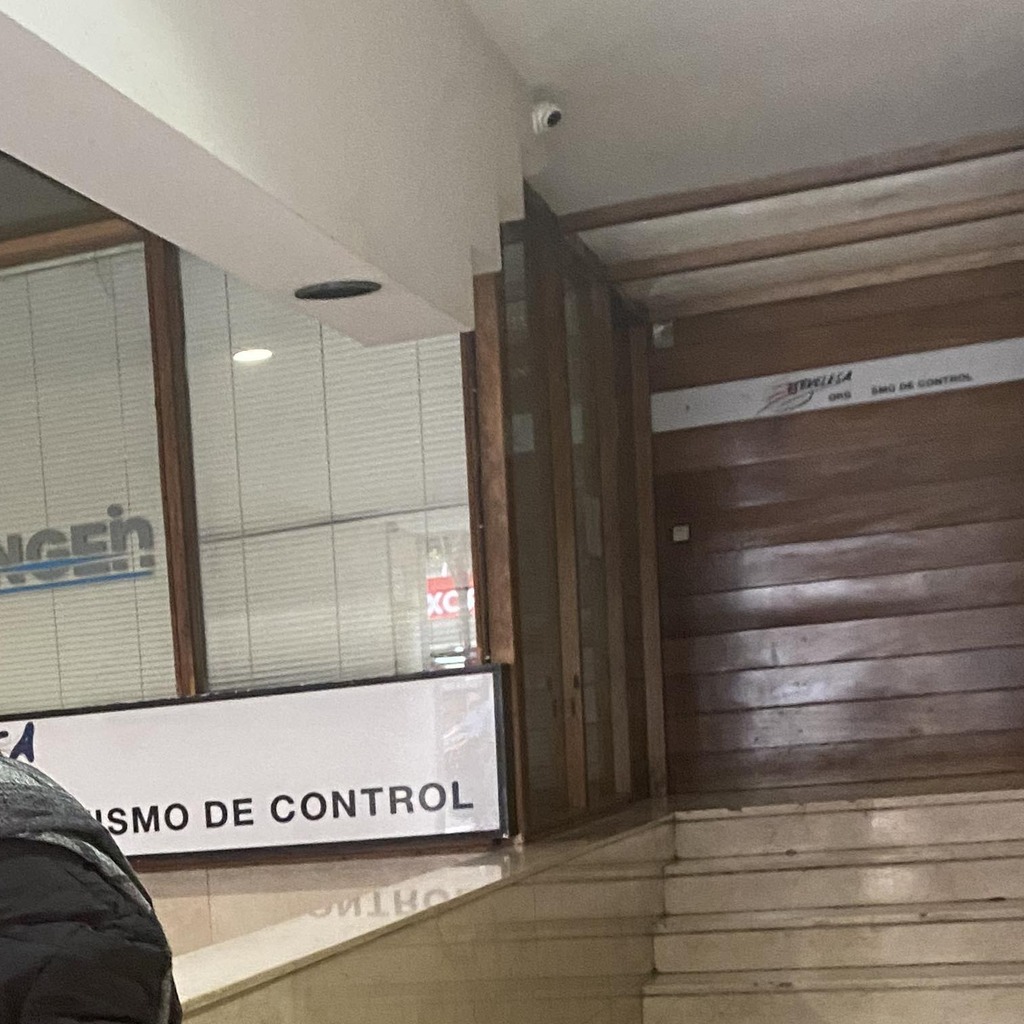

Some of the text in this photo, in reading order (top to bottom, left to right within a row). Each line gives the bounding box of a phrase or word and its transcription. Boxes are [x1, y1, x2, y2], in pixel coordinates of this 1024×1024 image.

[917, 373, 973, 388] CONTROL
[204, 798, 254, 829] DE
[270, 780, 474, 824] CONTROL
